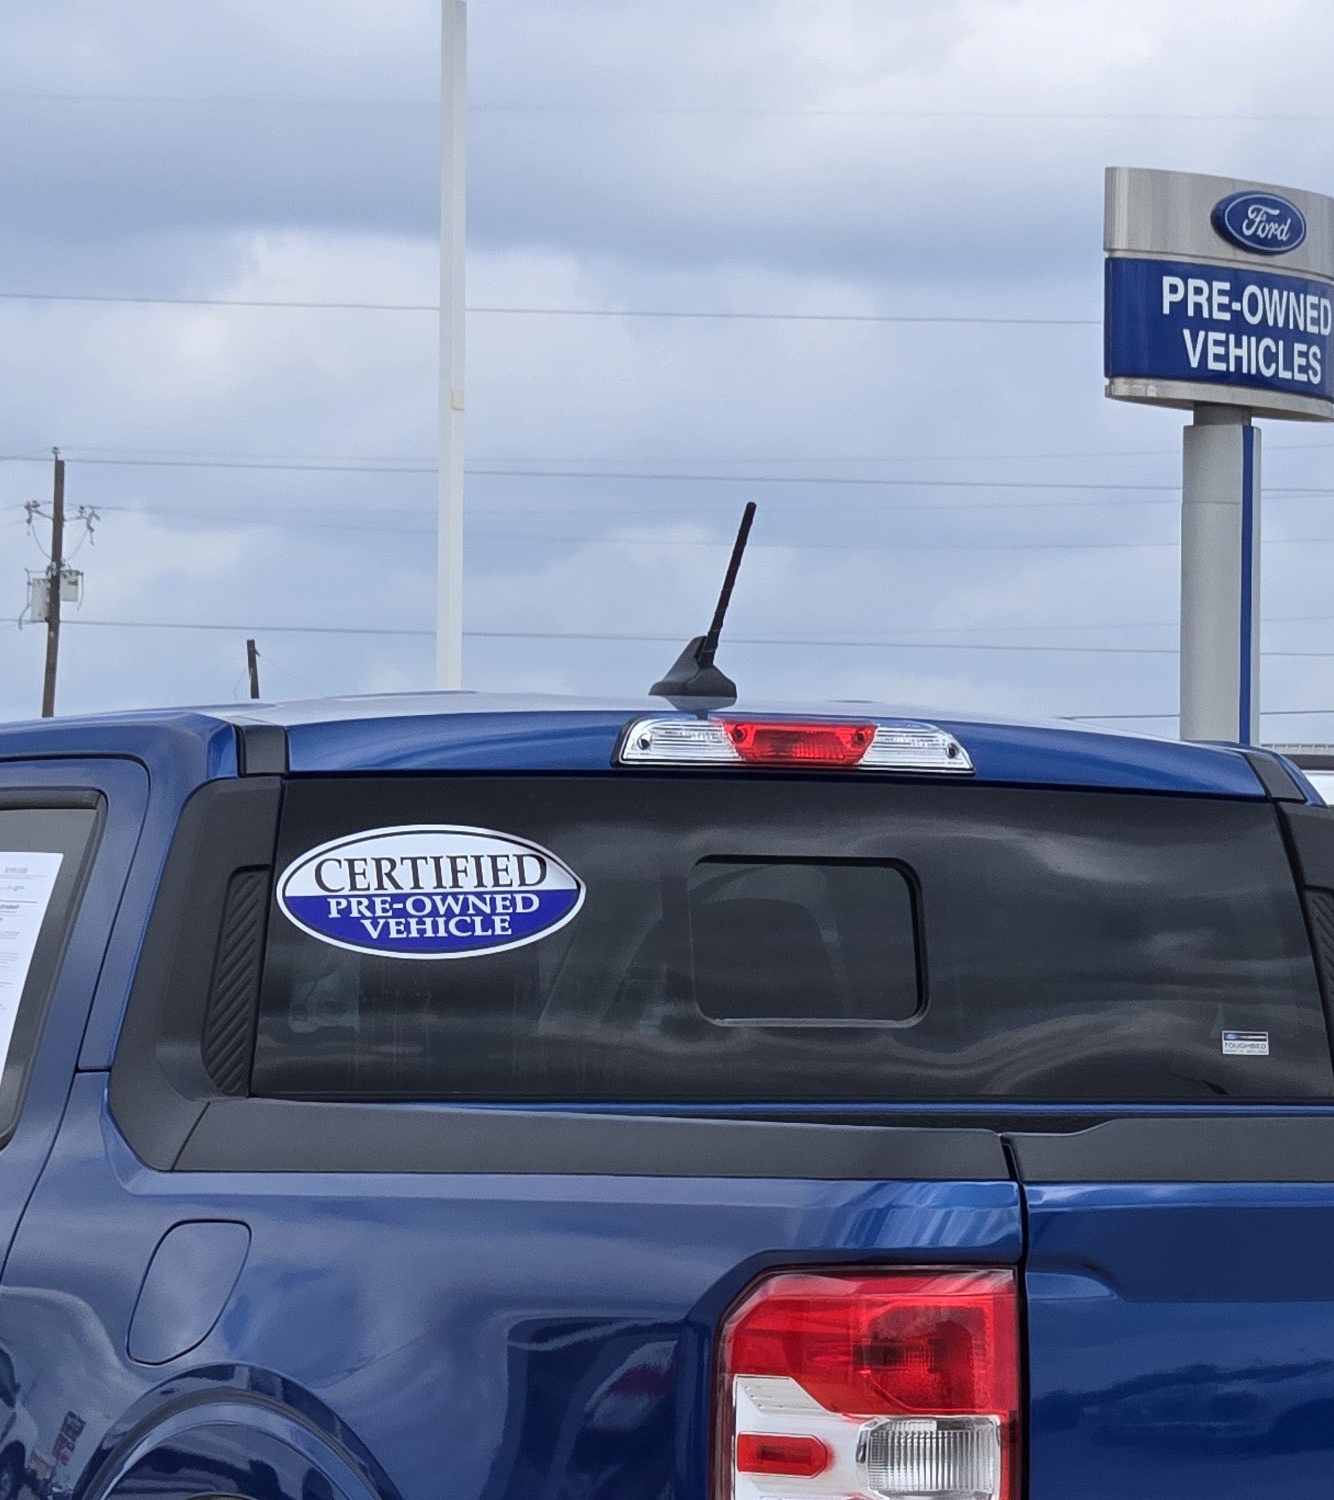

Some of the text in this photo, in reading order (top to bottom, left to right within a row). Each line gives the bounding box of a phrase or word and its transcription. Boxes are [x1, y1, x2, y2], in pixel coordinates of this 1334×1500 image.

[1242, 203, 1291, 242] Ford
[1162, 276, 1332, 336] PRE-OWNED
[1183, 329, 1322, 384] VEHICLES
[316, 853, 548, 893] CERTIFIED
[327, 893, 540, 918] PRE-OWNED
[360, 915, 512, 939] VEHICLE
